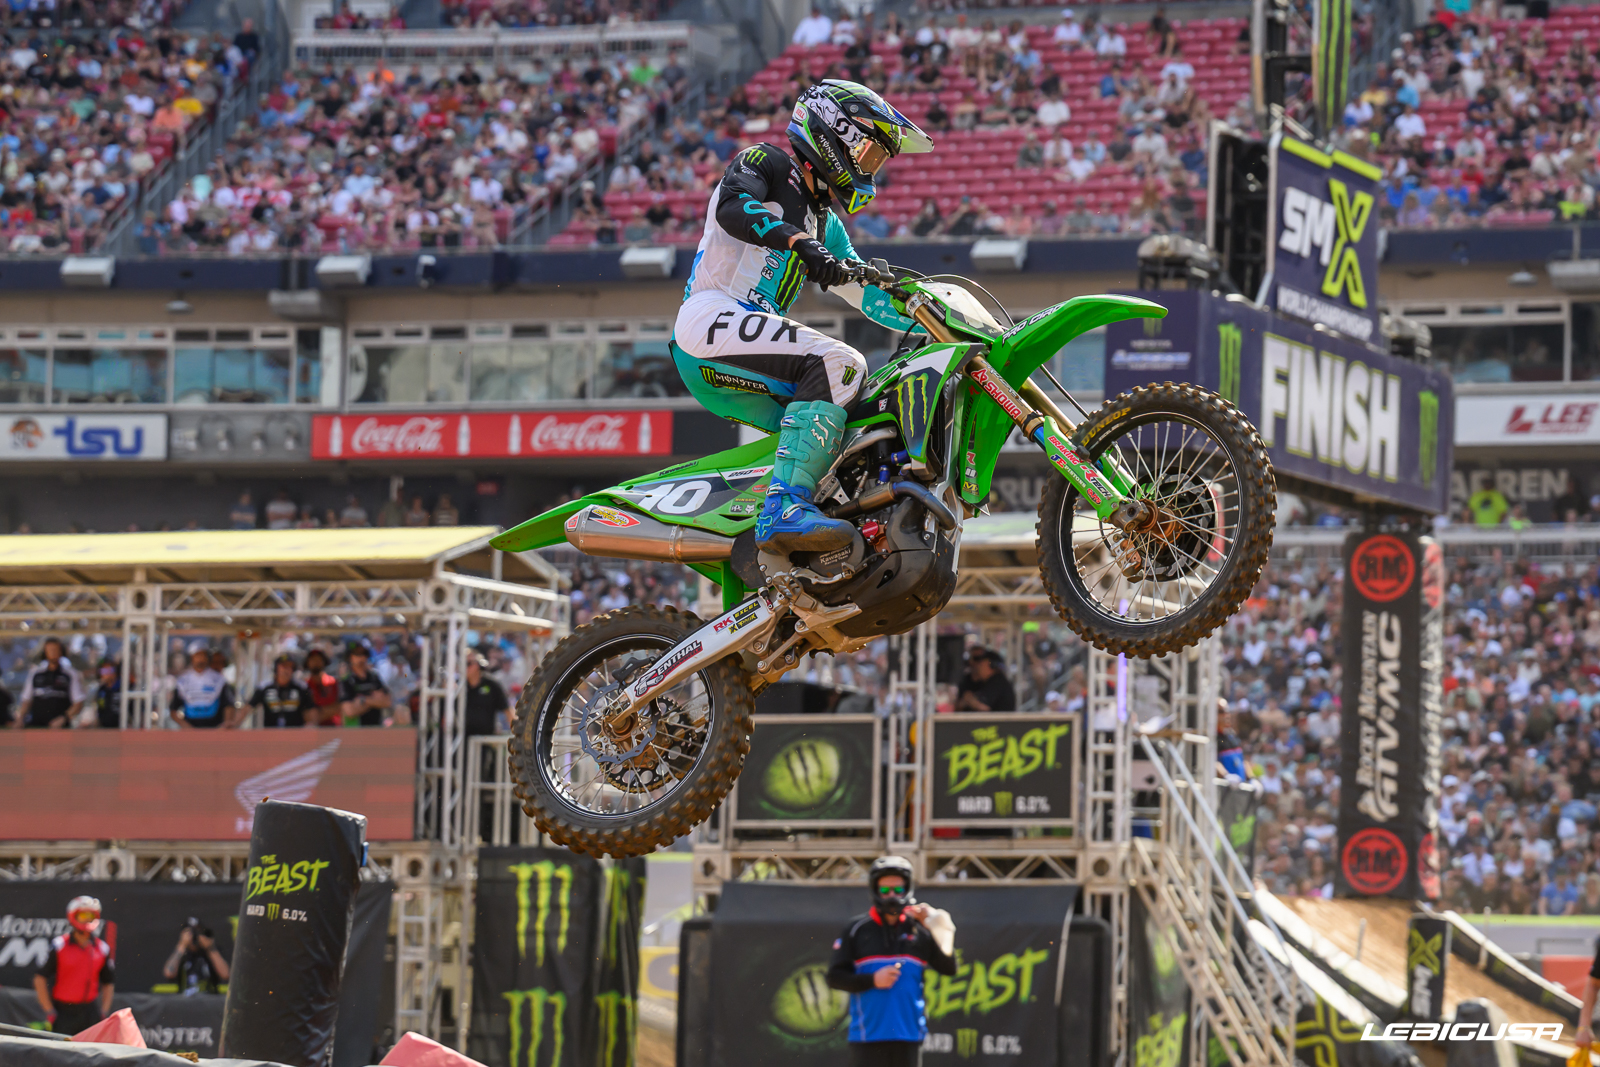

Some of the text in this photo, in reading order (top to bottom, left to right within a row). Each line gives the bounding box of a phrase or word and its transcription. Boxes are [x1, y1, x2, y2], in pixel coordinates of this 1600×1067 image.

[818, 133, 844, 174] MONSTER
[739, 193, 784, 238] FO
[809, 240, 836, 264] FOX
[1279, 177, 1374, 309] SMX
[706, 311, 800, 344] FOX
[715, 373, 768, 391] MONSTER
[983, 381, 1023, 420] SHOWA
[1262, 331, 1402, 484] FINISH
[1541, 403, 1600, 423] LEE
[53, 416, 144, 456] tsu
[1081, 407, 1131, 447] DUNLOP
[1047, 435, 1081, 466] BRAKING
[1050, 454, 1067, 468] JE
[636, 480, 712, 514] 10
[713, 616, 734, 632] RK
[734, 602, 759, 618] EXCEL
[1357, 610, 1378, 720] MOUNTAIN
[972, 726, 999, 742] THE
[944, 724, 1070, 795] BEAST
[957, 796, 1050, 814] HARD 6.0%
[261, 854, 276, 864] THE
[245, 858, 330, 900] BEAST
[246, 904, 308, 923] HARD 6.0%
[982, 1034, 1022, 1055] 6.0%
